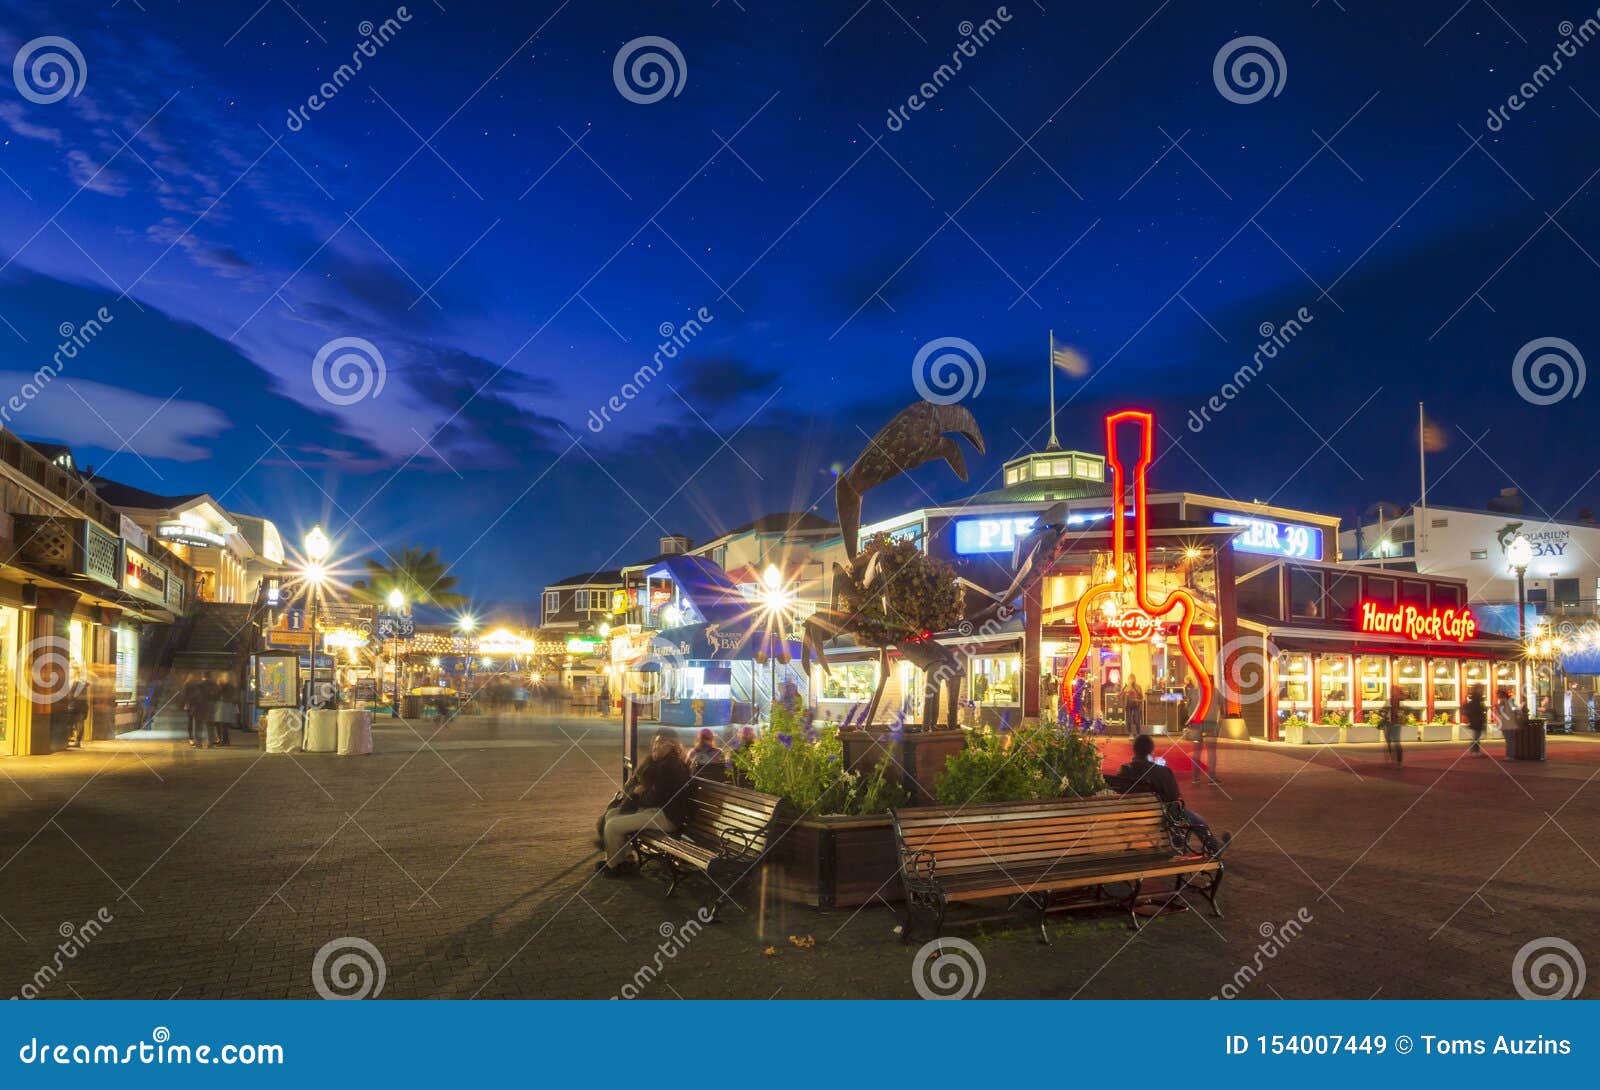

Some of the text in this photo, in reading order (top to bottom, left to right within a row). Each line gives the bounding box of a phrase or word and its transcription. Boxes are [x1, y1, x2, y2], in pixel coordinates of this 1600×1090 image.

[1284, 526, 1309, 556] 39
[400, 624, 414, 635] 39
[1107, 616, 1165, 631] Hard Rock
[1363, 602, 1475, 642] Hard Rock Cafe
